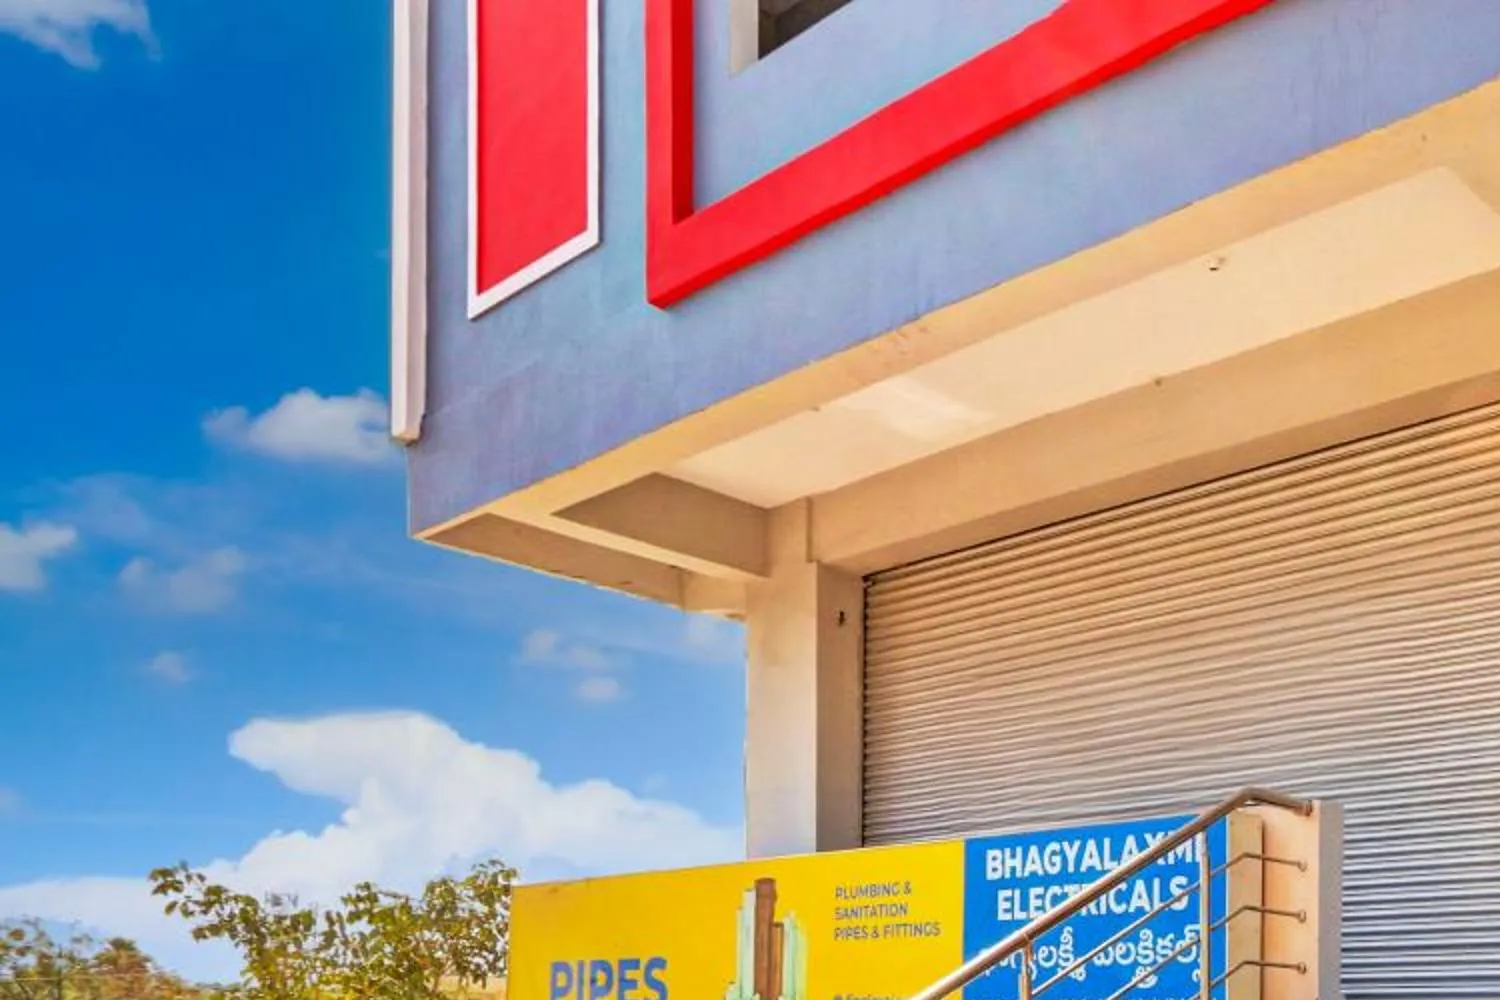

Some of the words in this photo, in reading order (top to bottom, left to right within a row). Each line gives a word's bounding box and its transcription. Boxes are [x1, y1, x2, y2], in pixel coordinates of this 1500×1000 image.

[835, 882, 900, 900] PLUMBING
[903, 881, 912, 896] &
[834, 903, 908, 920] SANITATION
[834, 926, 868, 940] PIPES
[871, 925, 879, 939] &
[883, 922, 941, 938] FITTINGS
